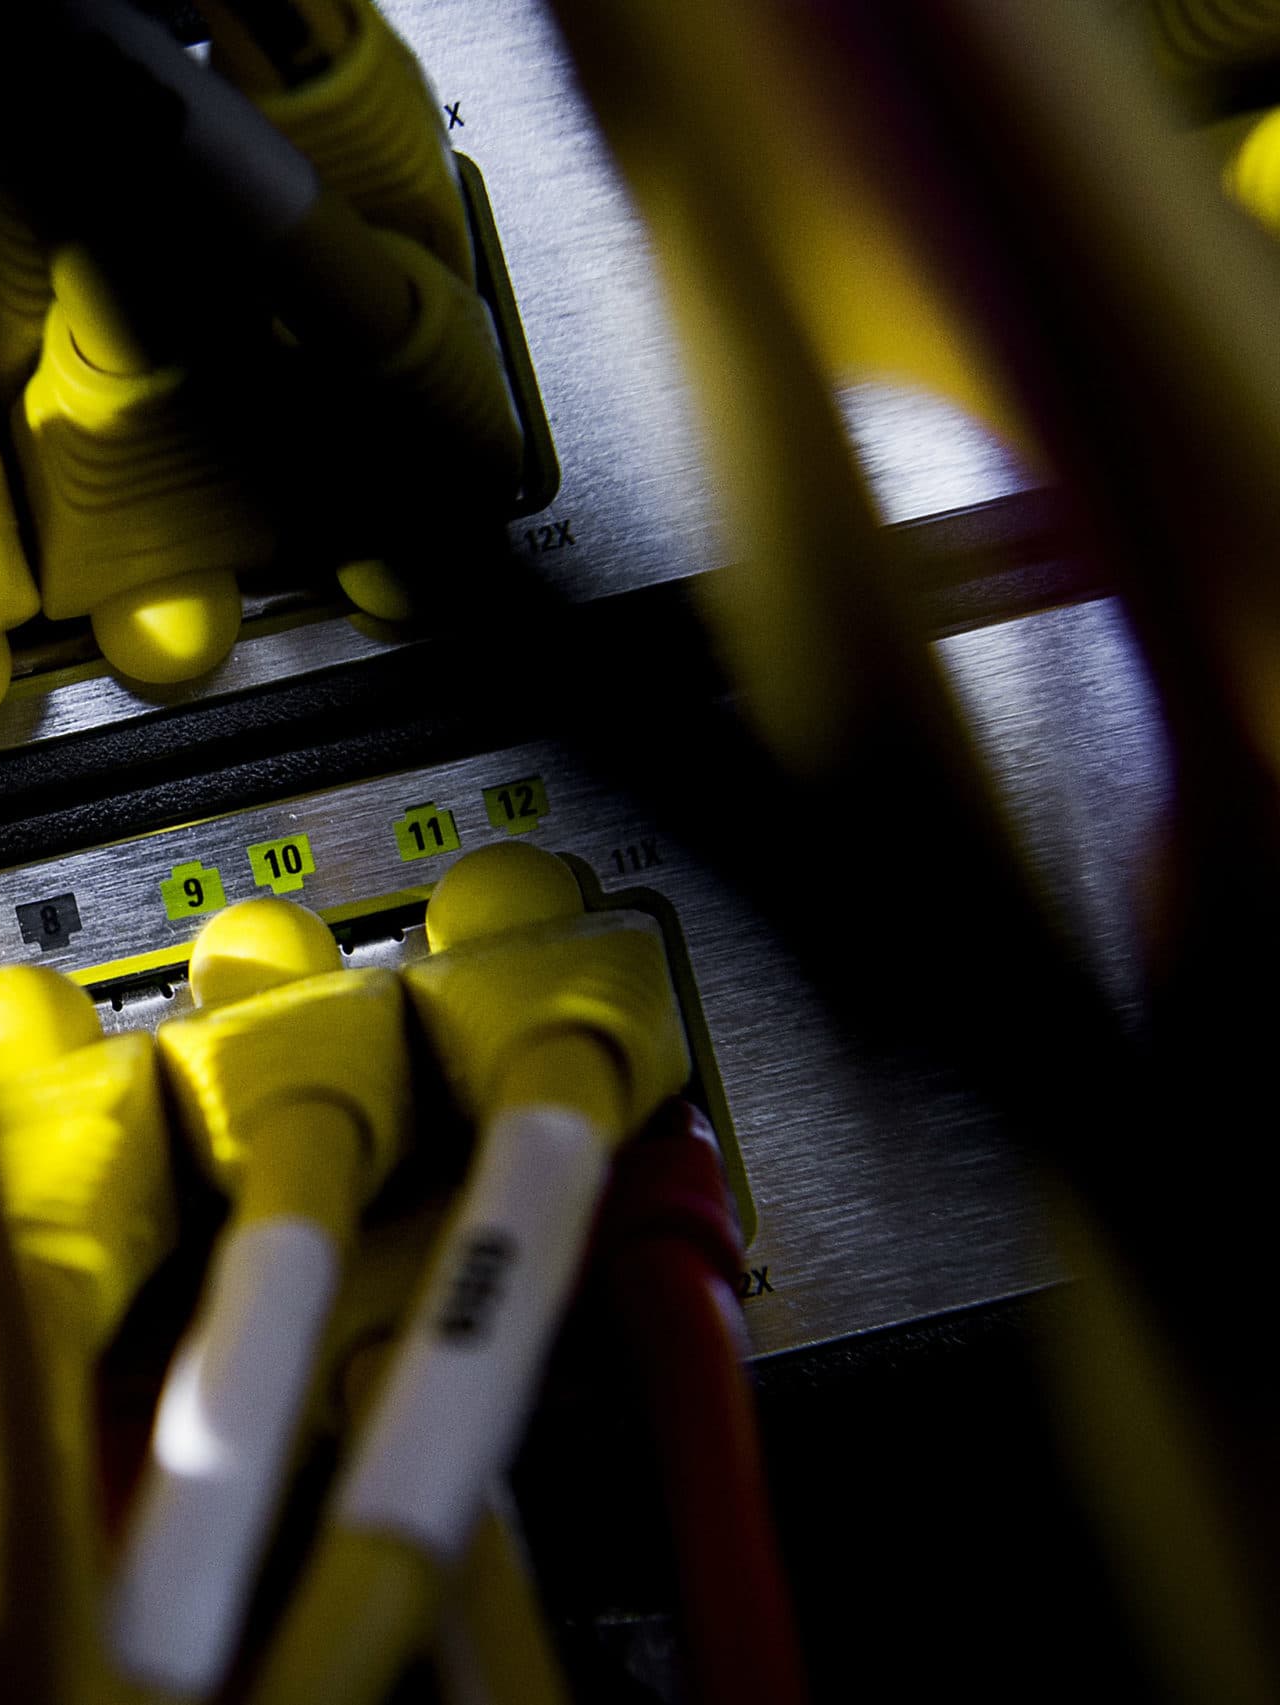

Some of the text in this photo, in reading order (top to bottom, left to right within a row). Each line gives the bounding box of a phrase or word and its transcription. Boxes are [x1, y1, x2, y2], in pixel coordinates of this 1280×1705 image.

[524, 519, 575, 554] 12X
[498, 785, 538, 819] 12
[408, 817, 444, 850] 11
[264, 844, 302, 878] 10
[611, 837, 663, 874] 11X
[183, 878, 204, 907] 9
[40, 905, 61, 935] 8
[734, 1265, 775, 1299] 2X
